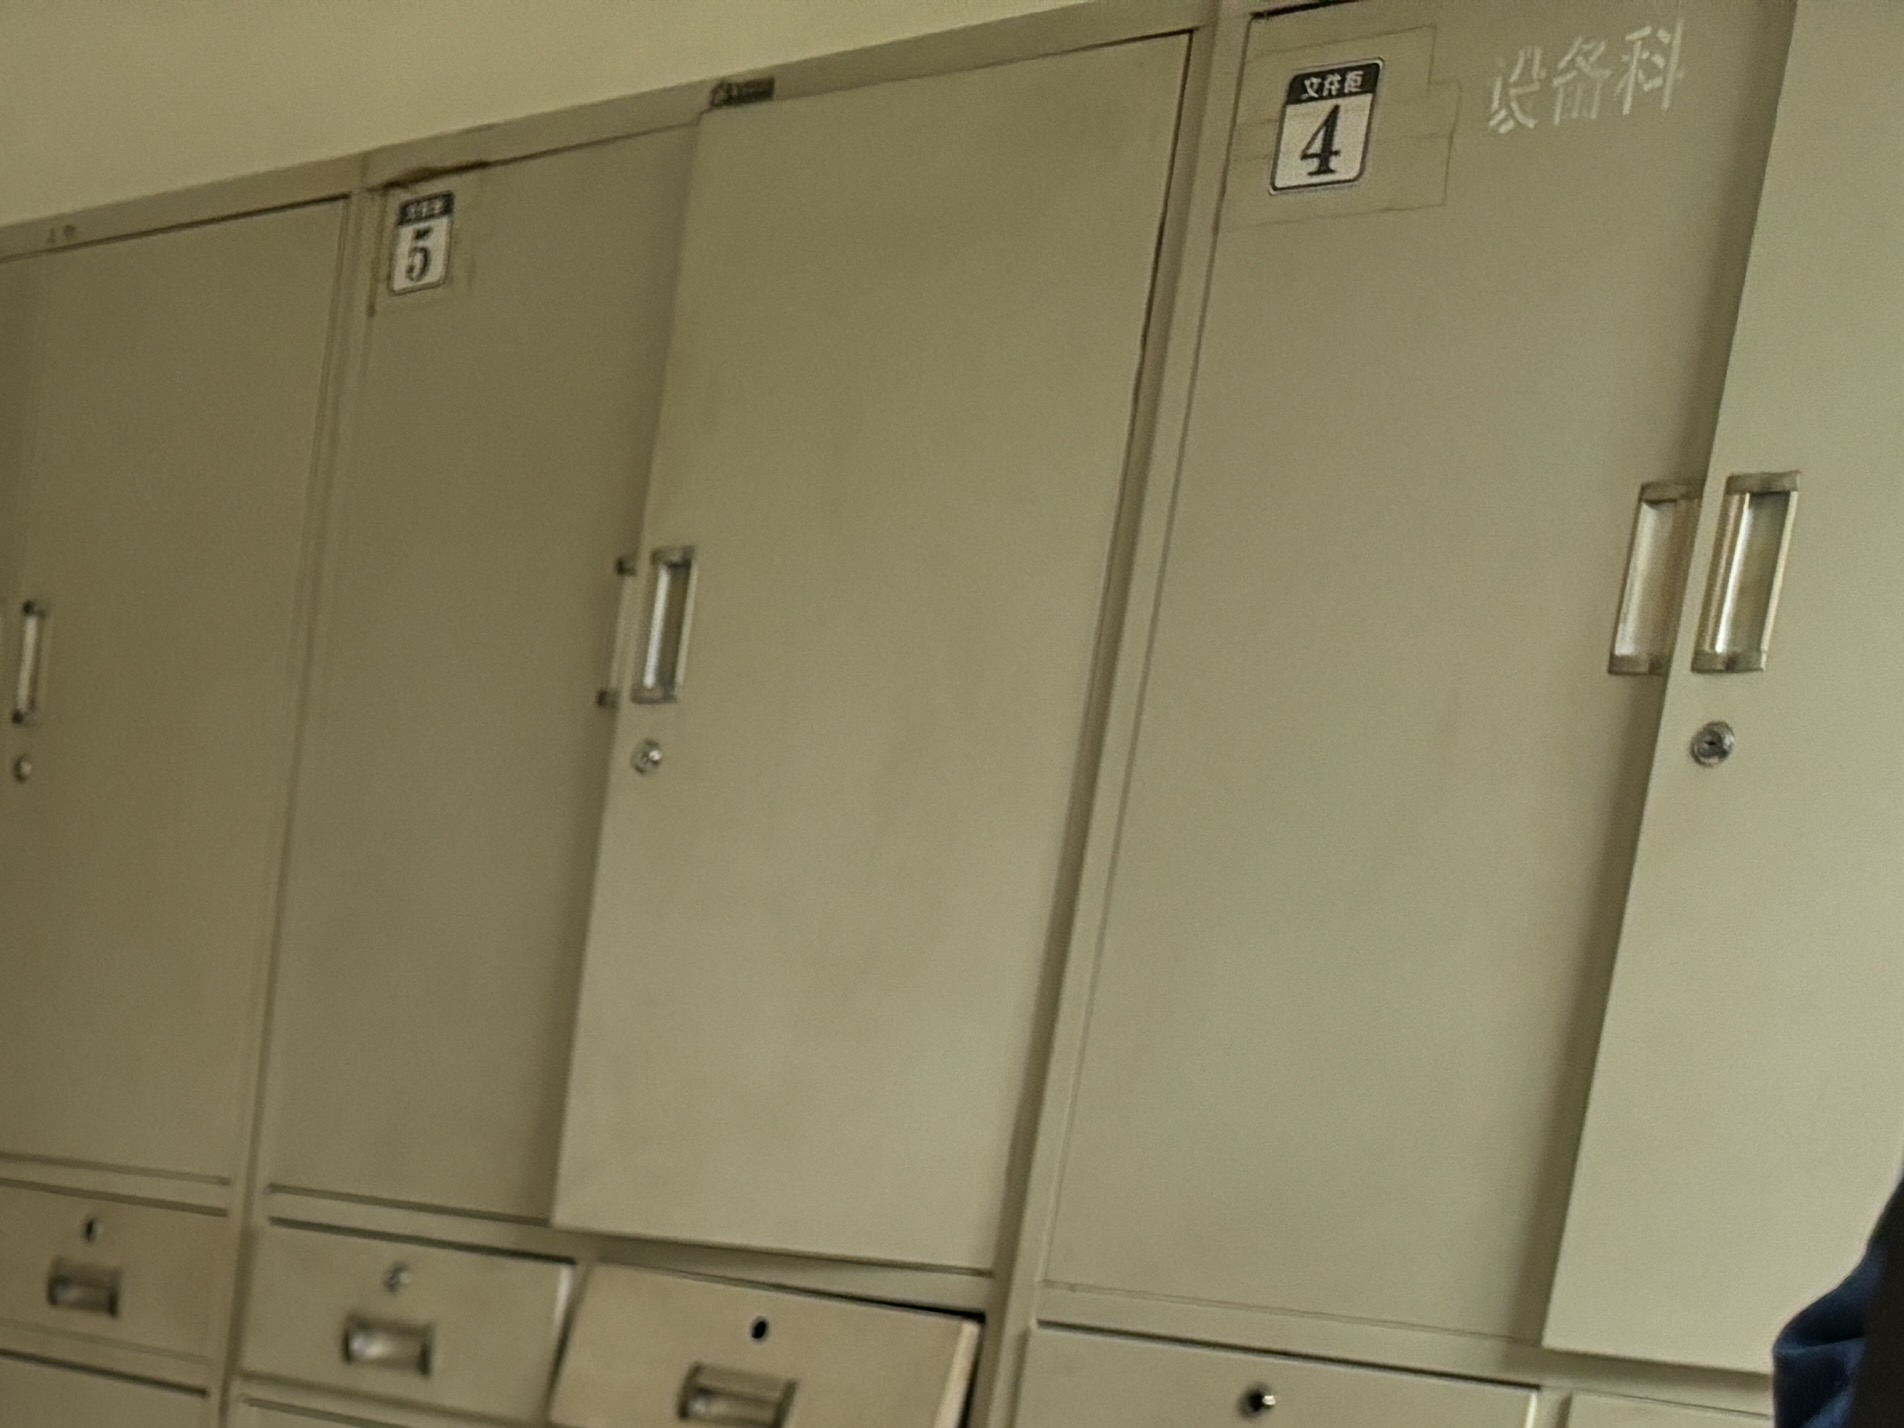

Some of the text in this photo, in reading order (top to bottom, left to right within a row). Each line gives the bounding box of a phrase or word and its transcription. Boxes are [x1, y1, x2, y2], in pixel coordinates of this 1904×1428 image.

[1300, 69, 1365, 100] 文件柜
[1488, 17, 1684, 135] 设备科
[1299, 105, 1342, 177] 4
[405, 226, 434, 283] 5
